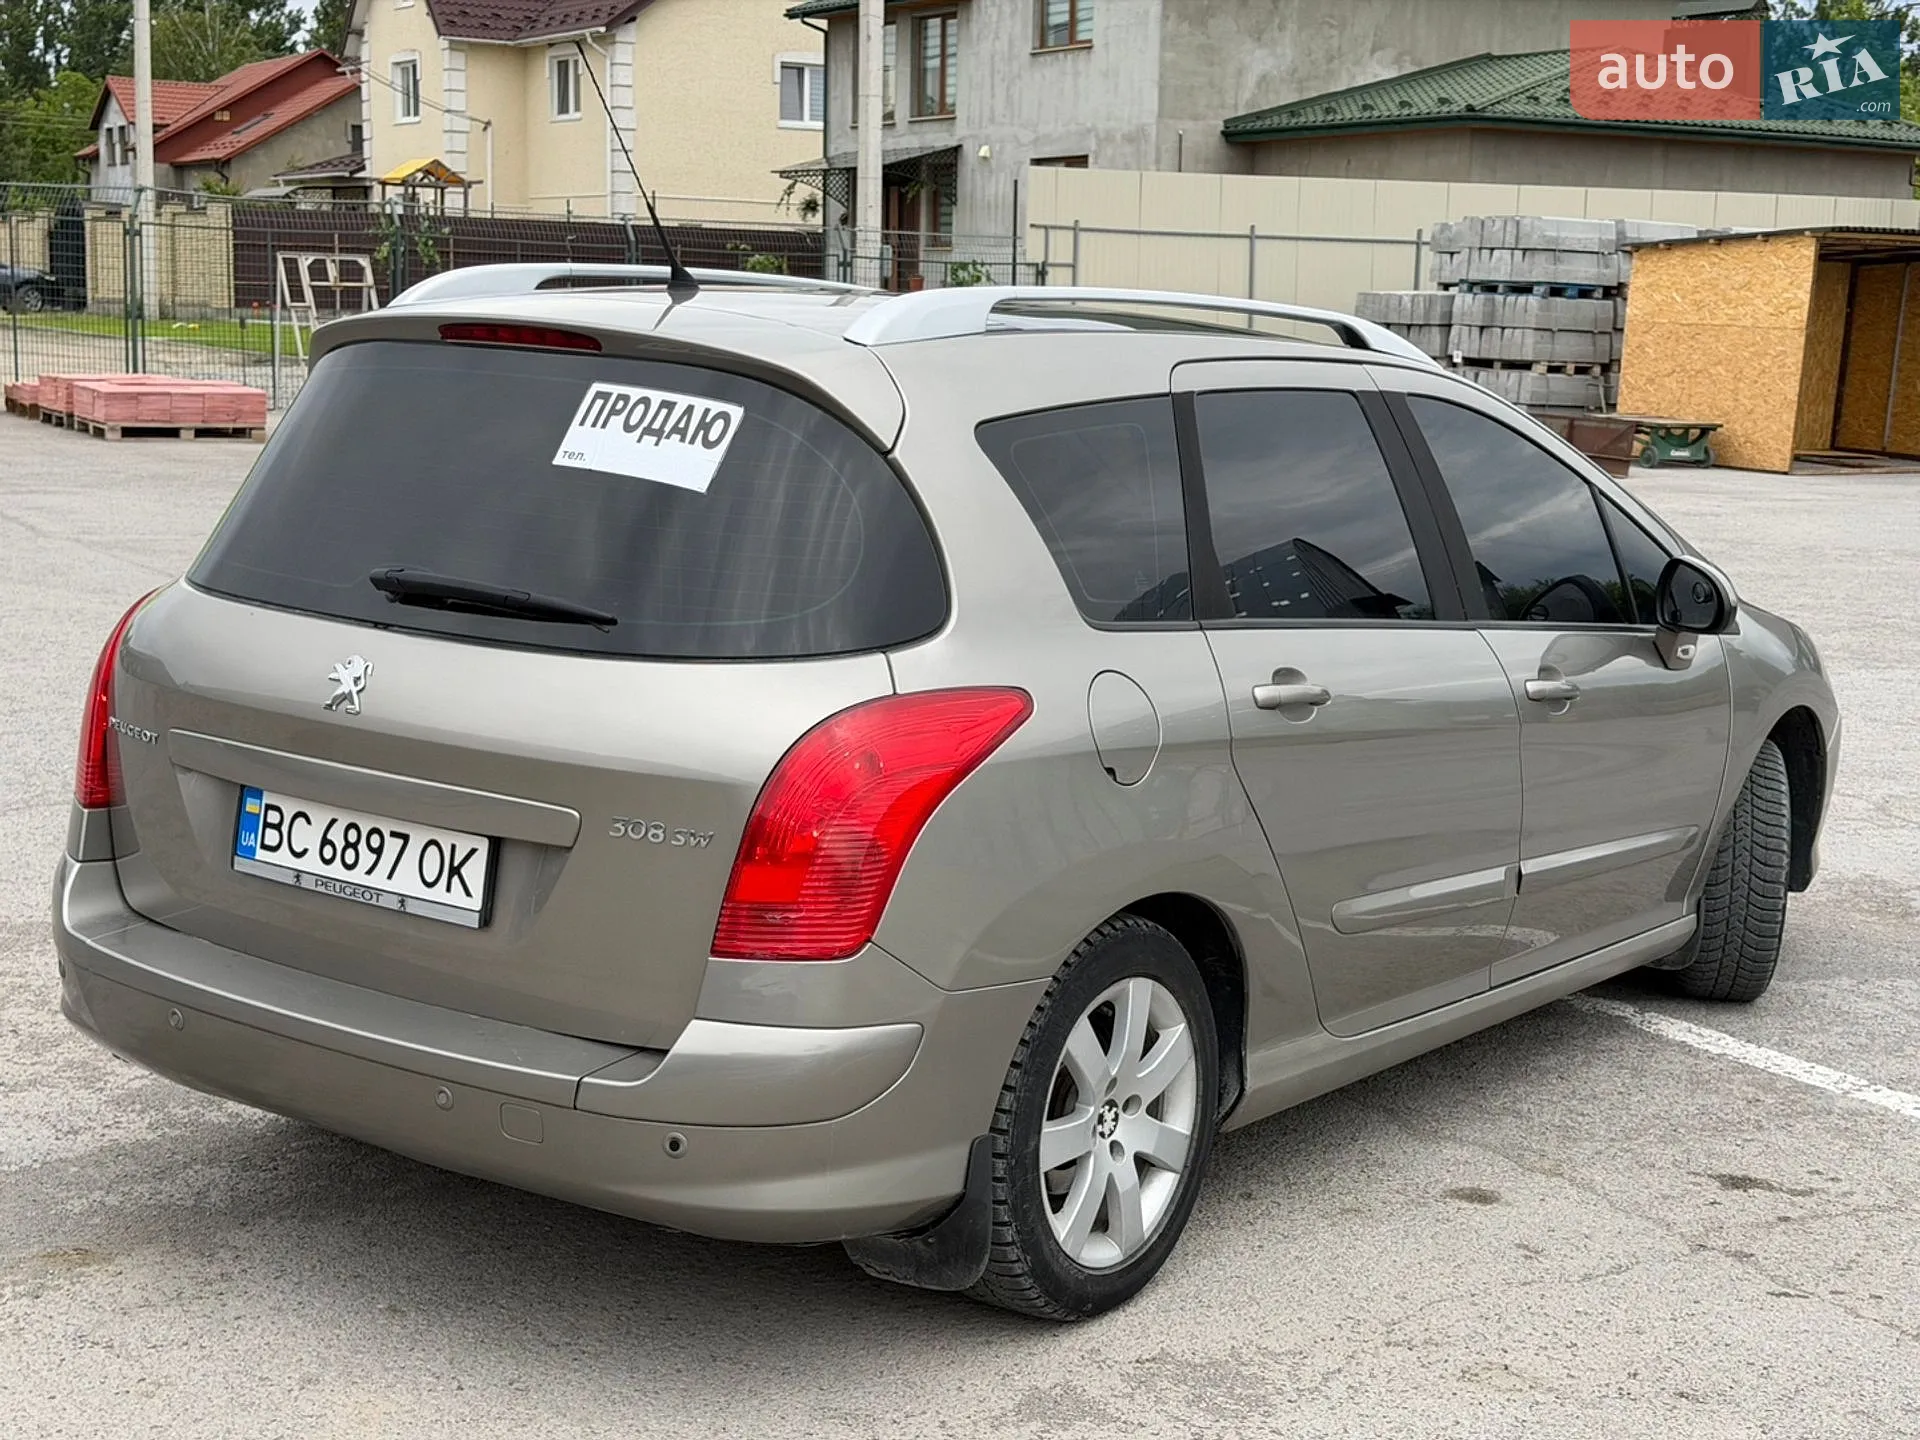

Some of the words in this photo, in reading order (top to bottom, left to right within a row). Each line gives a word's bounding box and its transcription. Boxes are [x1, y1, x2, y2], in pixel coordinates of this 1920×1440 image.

[578, 390, 732, 450] ПРОДАЮ
[562, 450, 587, 462] тел.
[108, 716, 159, 744] PEUGEOT
[241, 830, 256, 848] UA
[608, 816, 666, 843] 308
[260, 803, 312, 859] BC
[318, 818, 410, 880] 6897
[418, 838, 479, 898] OK
[314, 878, 383, 904] PEUGEOT
